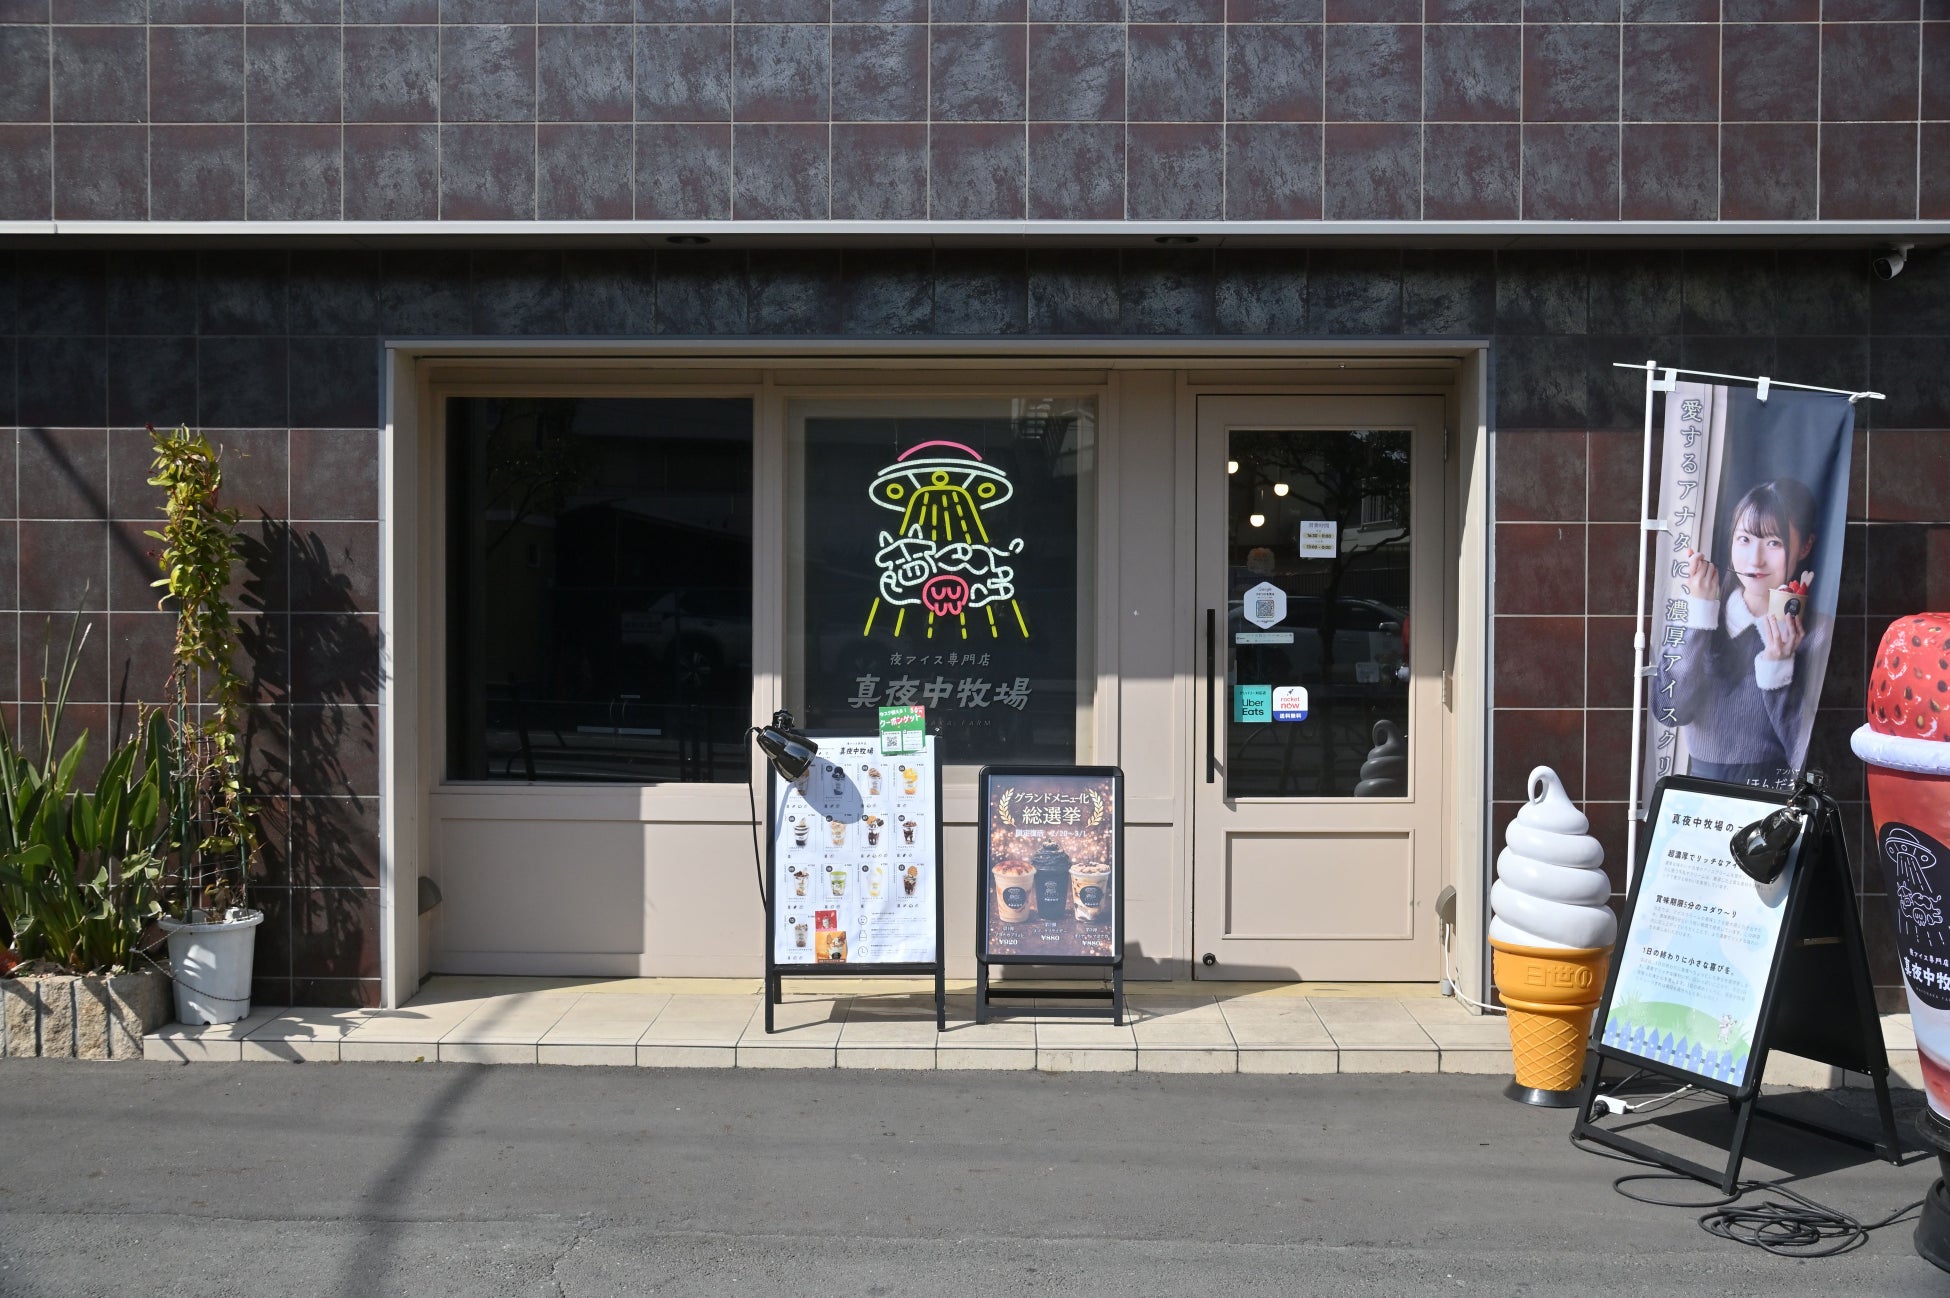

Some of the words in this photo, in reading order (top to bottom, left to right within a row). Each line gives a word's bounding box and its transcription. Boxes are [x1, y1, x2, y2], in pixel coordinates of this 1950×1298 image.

[889, 651, 991, 667] 夜アイス専門店
[847, 673, 1033, 711] 真夜中牧場
[1241, 698, 1264, 707] Uber
[1241, 708, 1265, 716] Eats
[879, 714, 922, 728] クーポンゲット
[1014, 792, 1090, 805] グランドメニュー化
[1022, 806, 1082, 826] 総選挙
[1671, 813, 1744, 833] 真夜中牧場の
[1903, 956, 1950, 991] 真夜中牧
